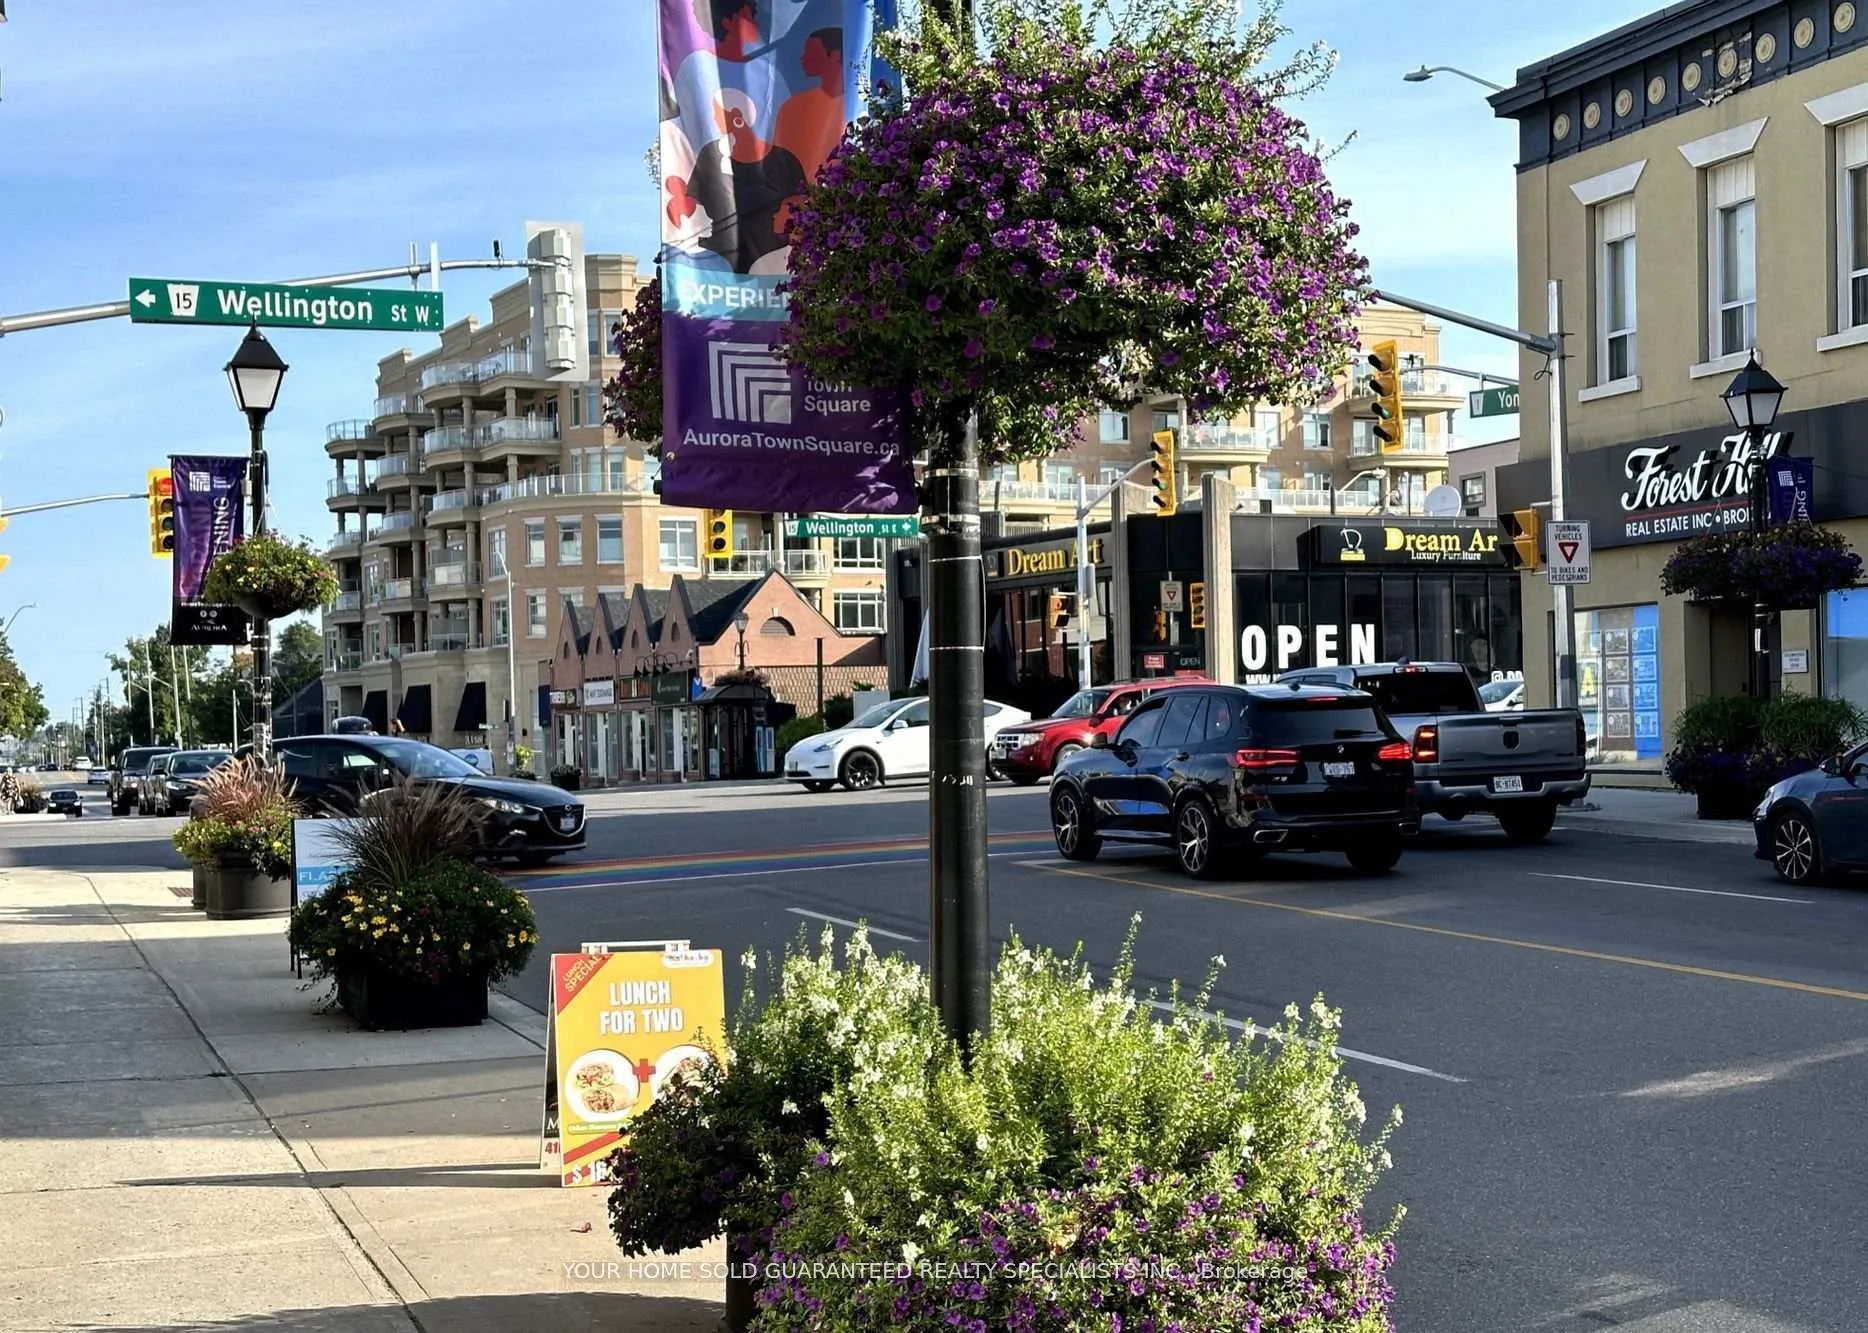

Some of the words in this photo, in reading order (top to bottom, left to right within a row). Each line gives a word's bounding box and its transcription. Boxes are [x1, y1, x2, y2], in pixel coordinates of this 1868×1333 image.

[175, 292, 192, 309] 15
[217, 289, 373, 324] Wellington
[391, 306, 407, 322] St
[415, 307, 430, 323] W
[804, 397, 871, 415] Square
[683, 429, 900, 456] AuroraTownSquare.ca
[1621, 446, 1710, 511] Forest
[805, 521, 875, 536] Wellington
[1625, 522, 1650, 537] REAL
[1654, 516, 1689, 534] ESTATE
[1692, 512, 1712, 529] INC
[1384, 527, 1457, 551] Dream
[1008, 548, 1066, 575] Dream
[1411, 551, 1440, 562] Luxury
[1241, 624, 1376, 670] OPEN
[609, 980, 671, 1007] LUNCH
[600, 1011, 636, 1035] FOR
[642, 1008, 683, 1032] TWO
[544, 1141, 561, 1154] 41
